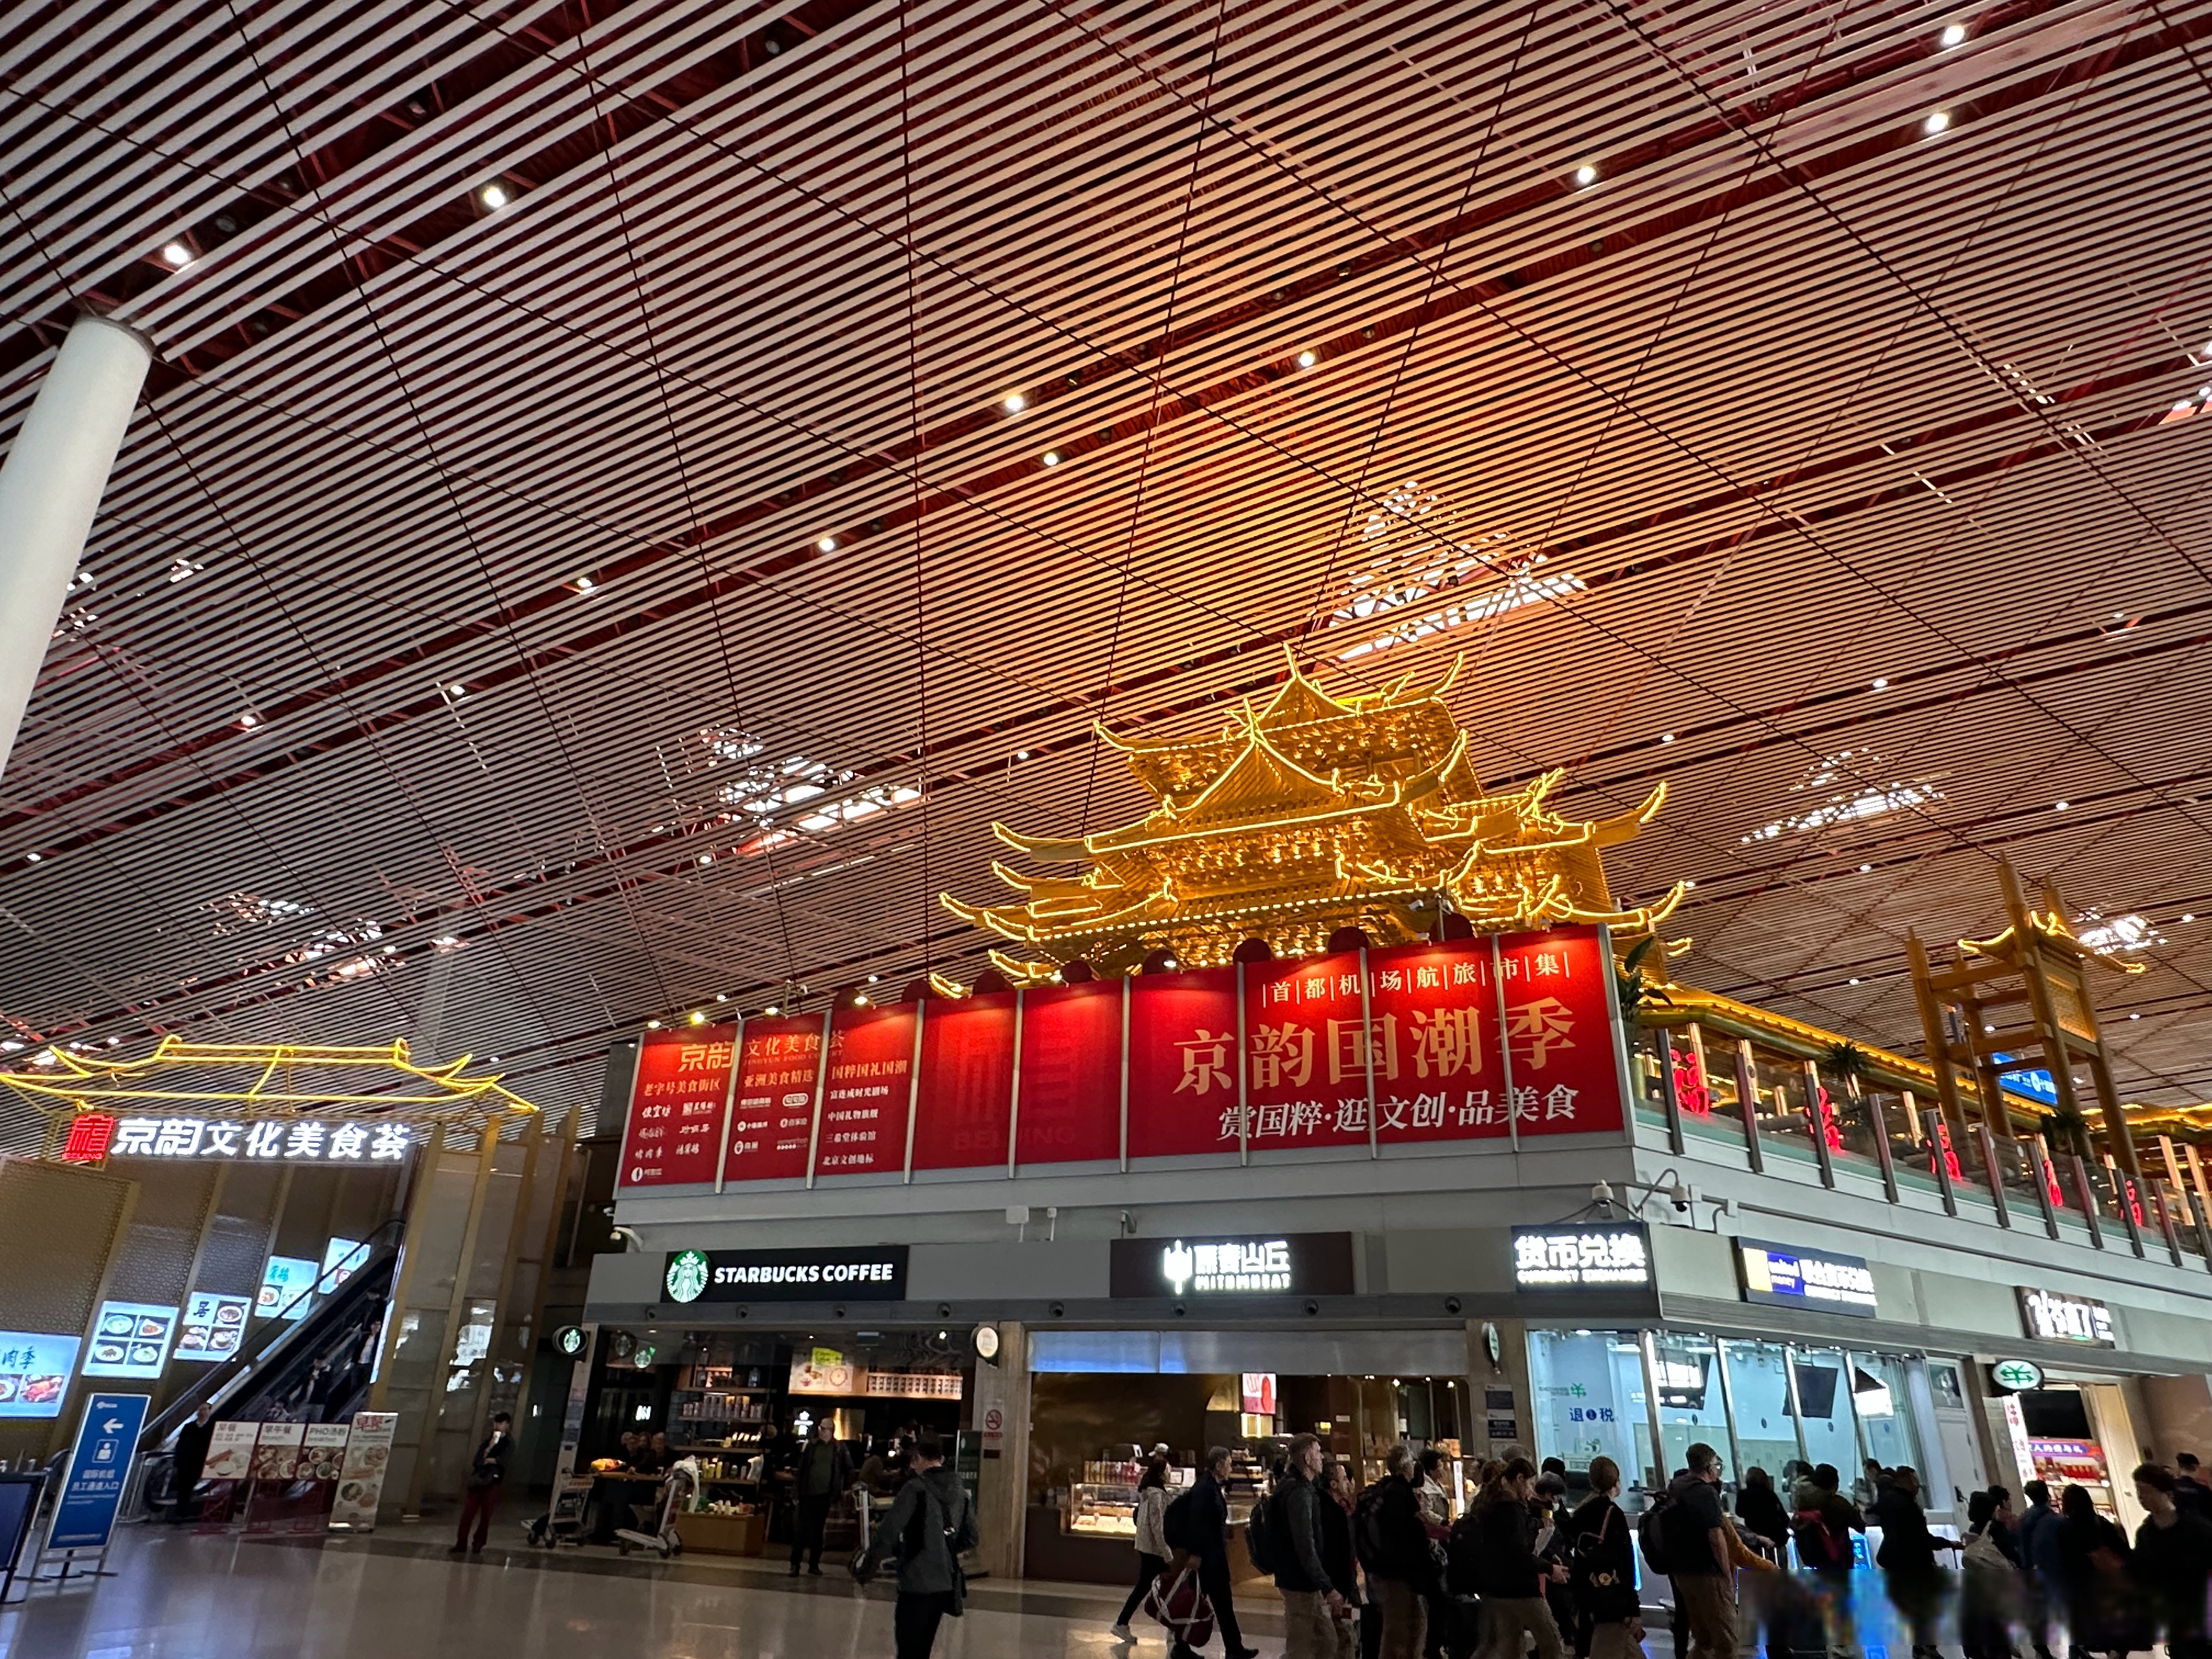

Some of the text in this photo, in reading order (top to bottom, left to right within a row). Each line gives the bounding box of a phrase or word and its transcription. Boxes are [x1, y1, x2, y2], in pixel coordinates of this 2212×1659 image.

[1173, 997, 1577, 1096] 京韵国潮季
[744, 1069, 814, 1087] 亚洲美食精选
[831, 1060, 907, 1080] 国粹国礼国潮
[644, 1077, 720, 1096] 老字号美食街区
[110, 1117, 413, 1160] 京韵文化美食荟
[1514, 1233, 1646, 1268] 货币兑换
[714, 1263, 893, 1285] STARBUCKS COFFEE
